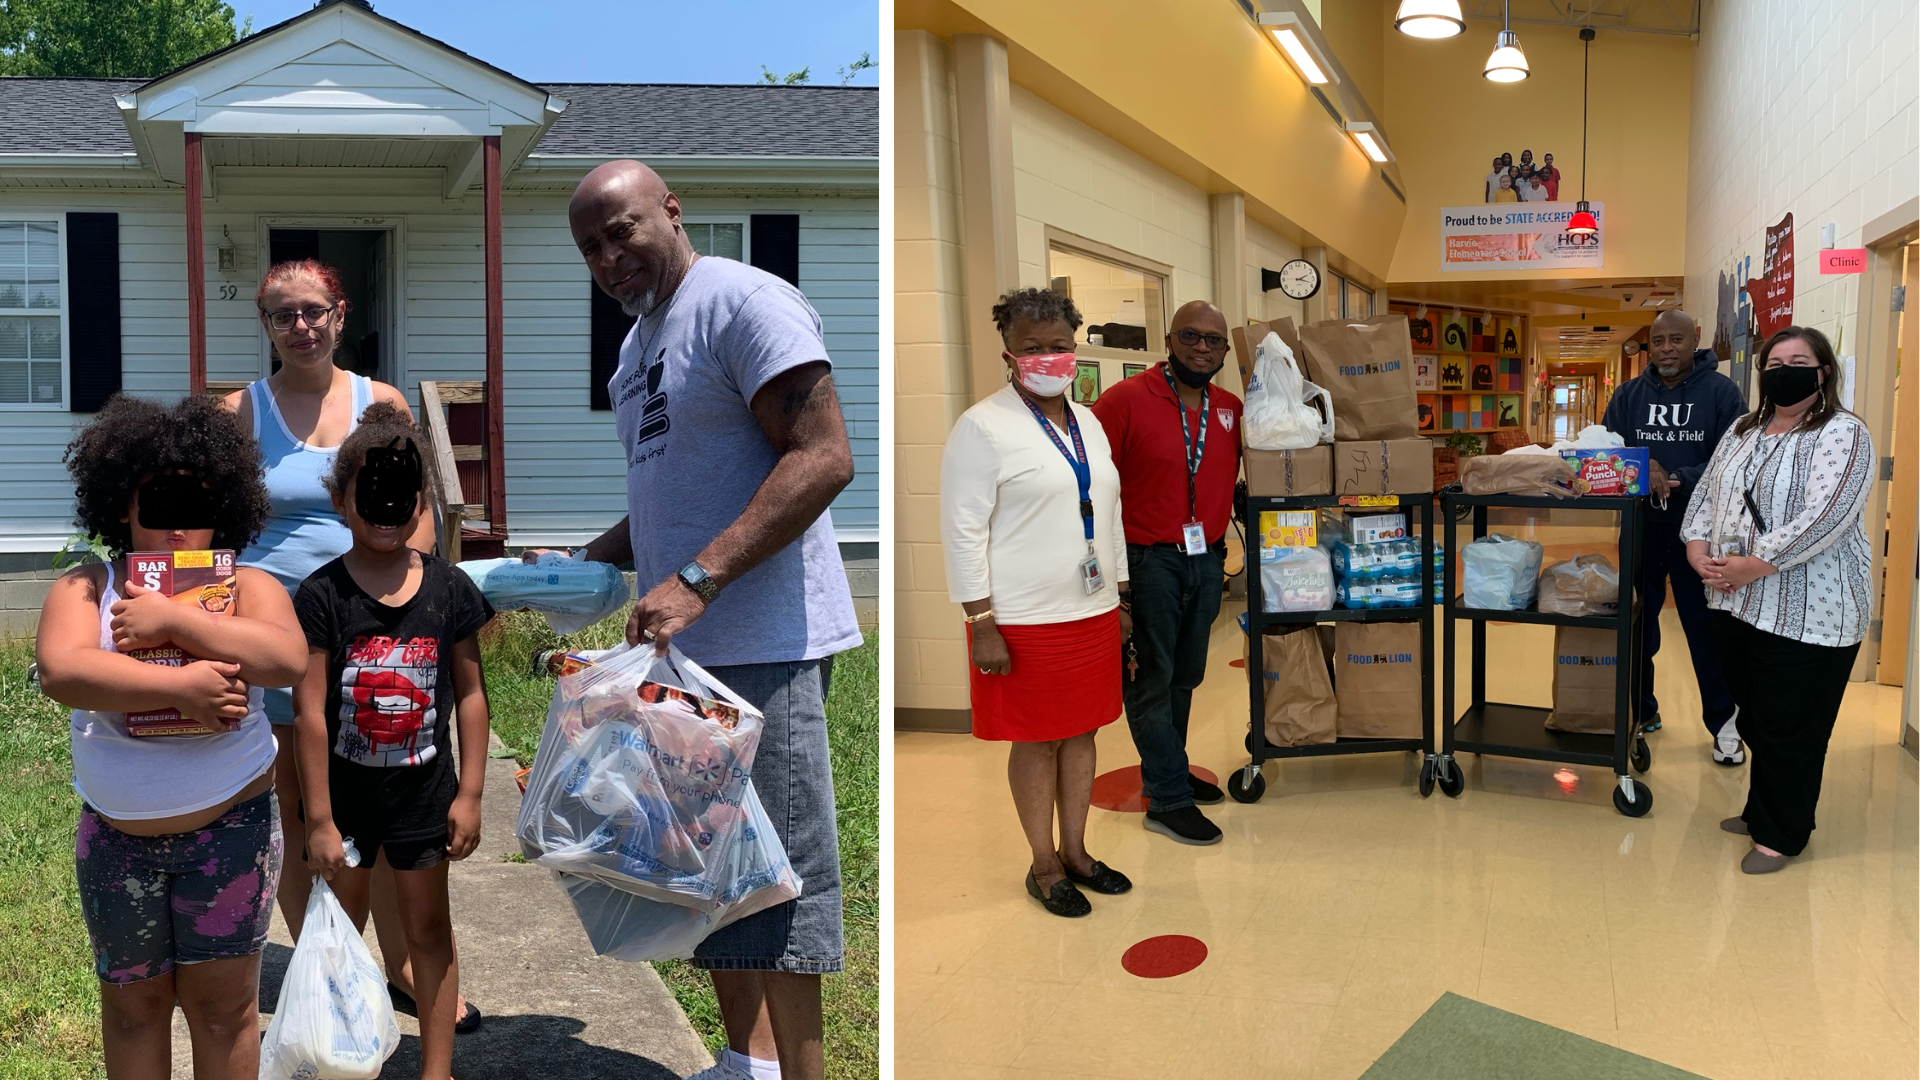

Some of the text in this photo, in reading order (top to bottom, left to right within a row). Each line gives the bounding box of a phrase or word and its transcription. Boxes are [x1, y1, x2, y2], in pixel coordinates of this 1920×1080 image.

[1445, 214, 1475, 227] Proud
[1477, 215, 1488, 226] to
[1489, 214, 1503, 225] be
[1505, 212, 1534, 225] STATE
[1449, 238, 1477, 248] Harvie
[1557, 233, 1599, 246] HCPS
[1449, 248, 1527, 259] Elementary School
[1829, 256, 1860, 267] Clinic
[219, 285, 238, 300] 59
[1339, 365, 1364, 376] FOOD
[1379, 360, 1400, 373] LION
[1645, 403, 1695, 427] RU
[1635, 428, 1705, 442] Track & Field
[1588, 464, 1609, 473] Fruit
[1586, 470, 1616, 481] Punch
[214, 553, 232, 567] 16
[137, 561, 168, 573] BAR
[144, 571, 161, 591] S
[500, 573, 511, 581] the
[511, 574, 525, 582] App
[526, 574, 545, 583] today
[130, 648, 182, 659] CLASSIC
[344, 634, 401, 668] BABY
[1347, 653, 1412, 664] FOOD LION
[1558, 655, 1579, 665] OOD
[618, 730, 685, 770] Walmart
[622, 759, 644, 777] Pay
[673, 783, 700, 797] your
[701, 791, 741, 809] phone
[648, 812, 660, 823] the
